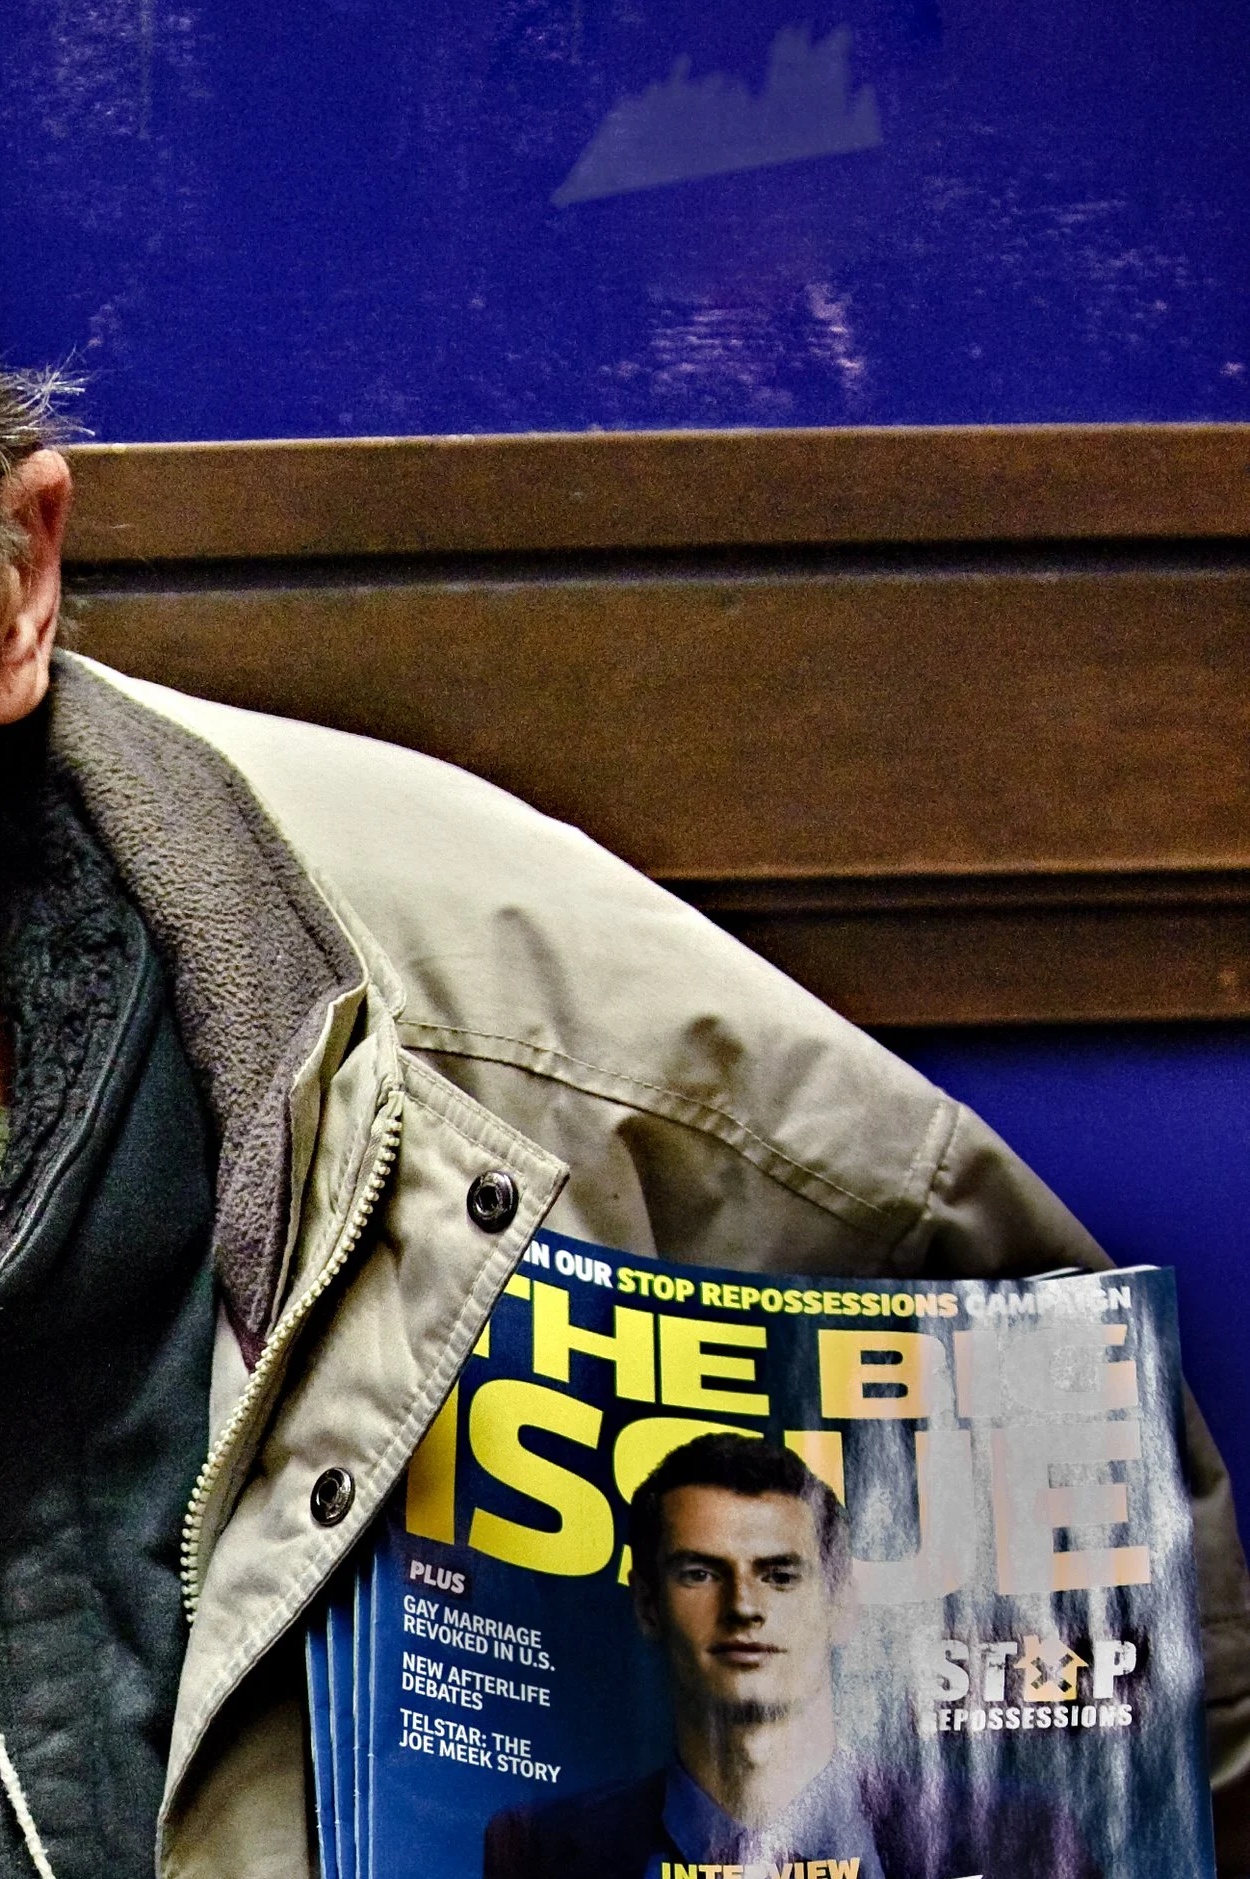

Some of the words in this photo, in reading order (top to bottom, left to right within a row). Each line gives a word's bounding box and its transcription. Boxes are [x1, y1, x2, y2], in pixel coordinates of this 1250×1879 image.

[555, 1250, 613, 1288] OUR
[617, 1267, 695, 1302] STOP
[701, 1281, 958, 1318] REPOSSESSIONS
[410, 1560, 466, 1594] PLUS
[403, 1594, 440, 1620] GAY
[444, 1606, 542, 1649] MARRIAGE
[404, 1614, 488, 1655] REVOKED
[494, 1640, 514, 1662] IN
[519, 1646, 556, 1672] U.S.
[402, 1651, 443, 1680] NEW
[448, 1665, 551, 1707] AFTERLIFE
[402, 1672, 483, 1711] DEBATES
[399, 1729, 434, 1754] JOE
[439, 1740, 493, 1769] MEEK
[497, 1754, 561, 1783] STORY
[400, 1708, 487, 1748] TELSTAR:
[491, 1732, 531, 1759] THE
